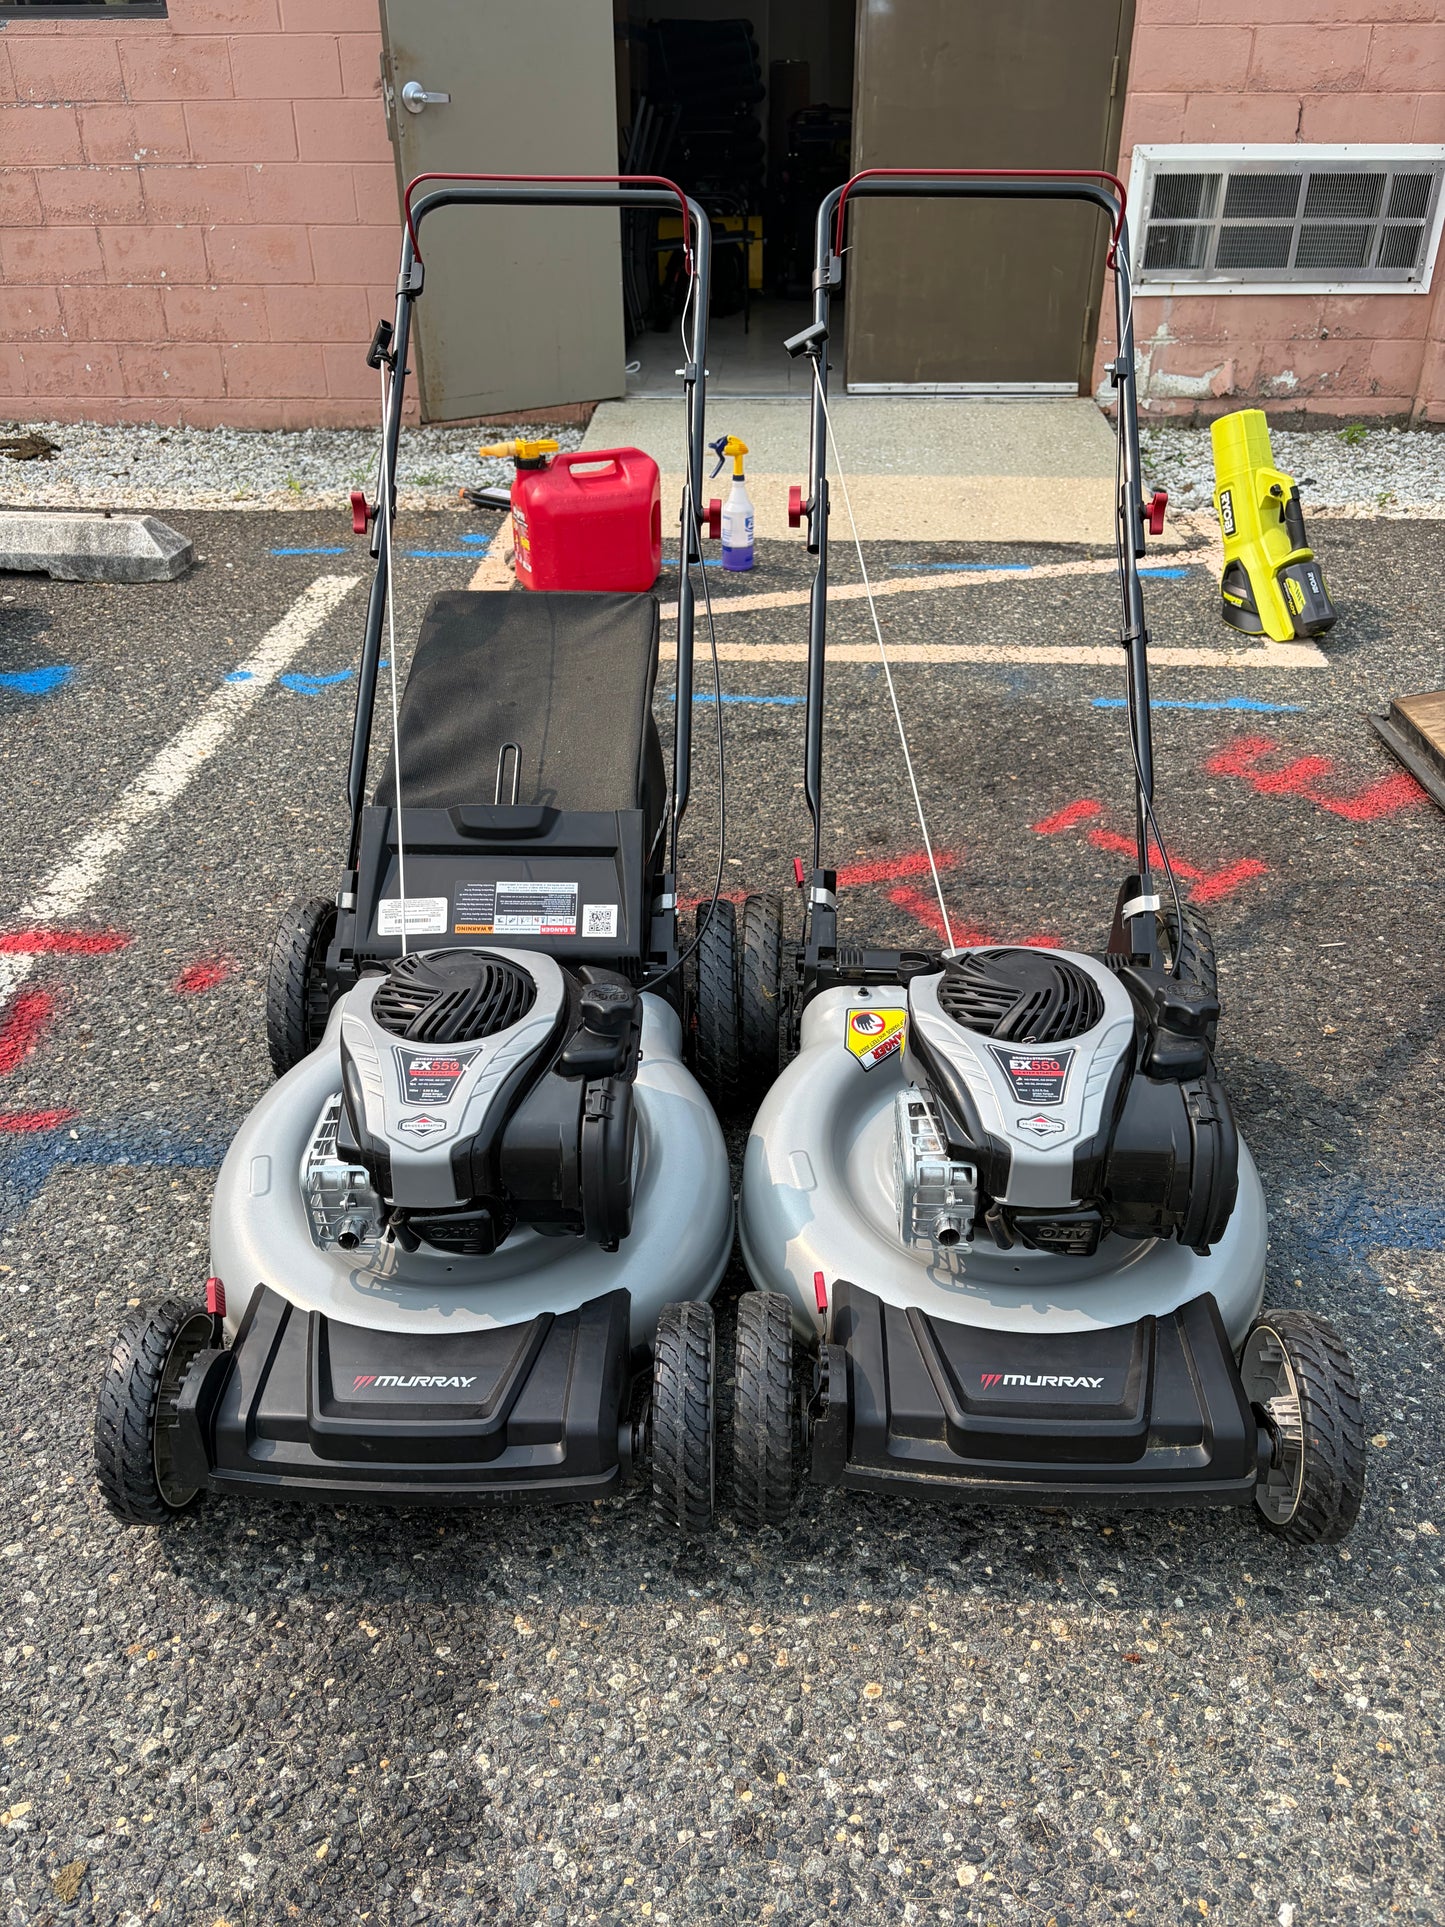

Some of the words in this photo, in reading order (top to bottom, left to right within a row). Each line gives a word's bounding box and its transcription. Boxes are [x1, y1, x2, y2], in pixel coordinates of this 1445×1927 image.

[1220, 491, 1234, 534] RYOBI
[1307, 572, 1319, 594] RYOBI
[871, 1032, 903, 1060] ANGER
[409, 1061, 460, 1071] EX550
[1009, 1060, 1060, 1071] EX550
[374, 1375, 478, 1388] MURRAY
[1003, 1374, 1105, 1388] MURRAY
